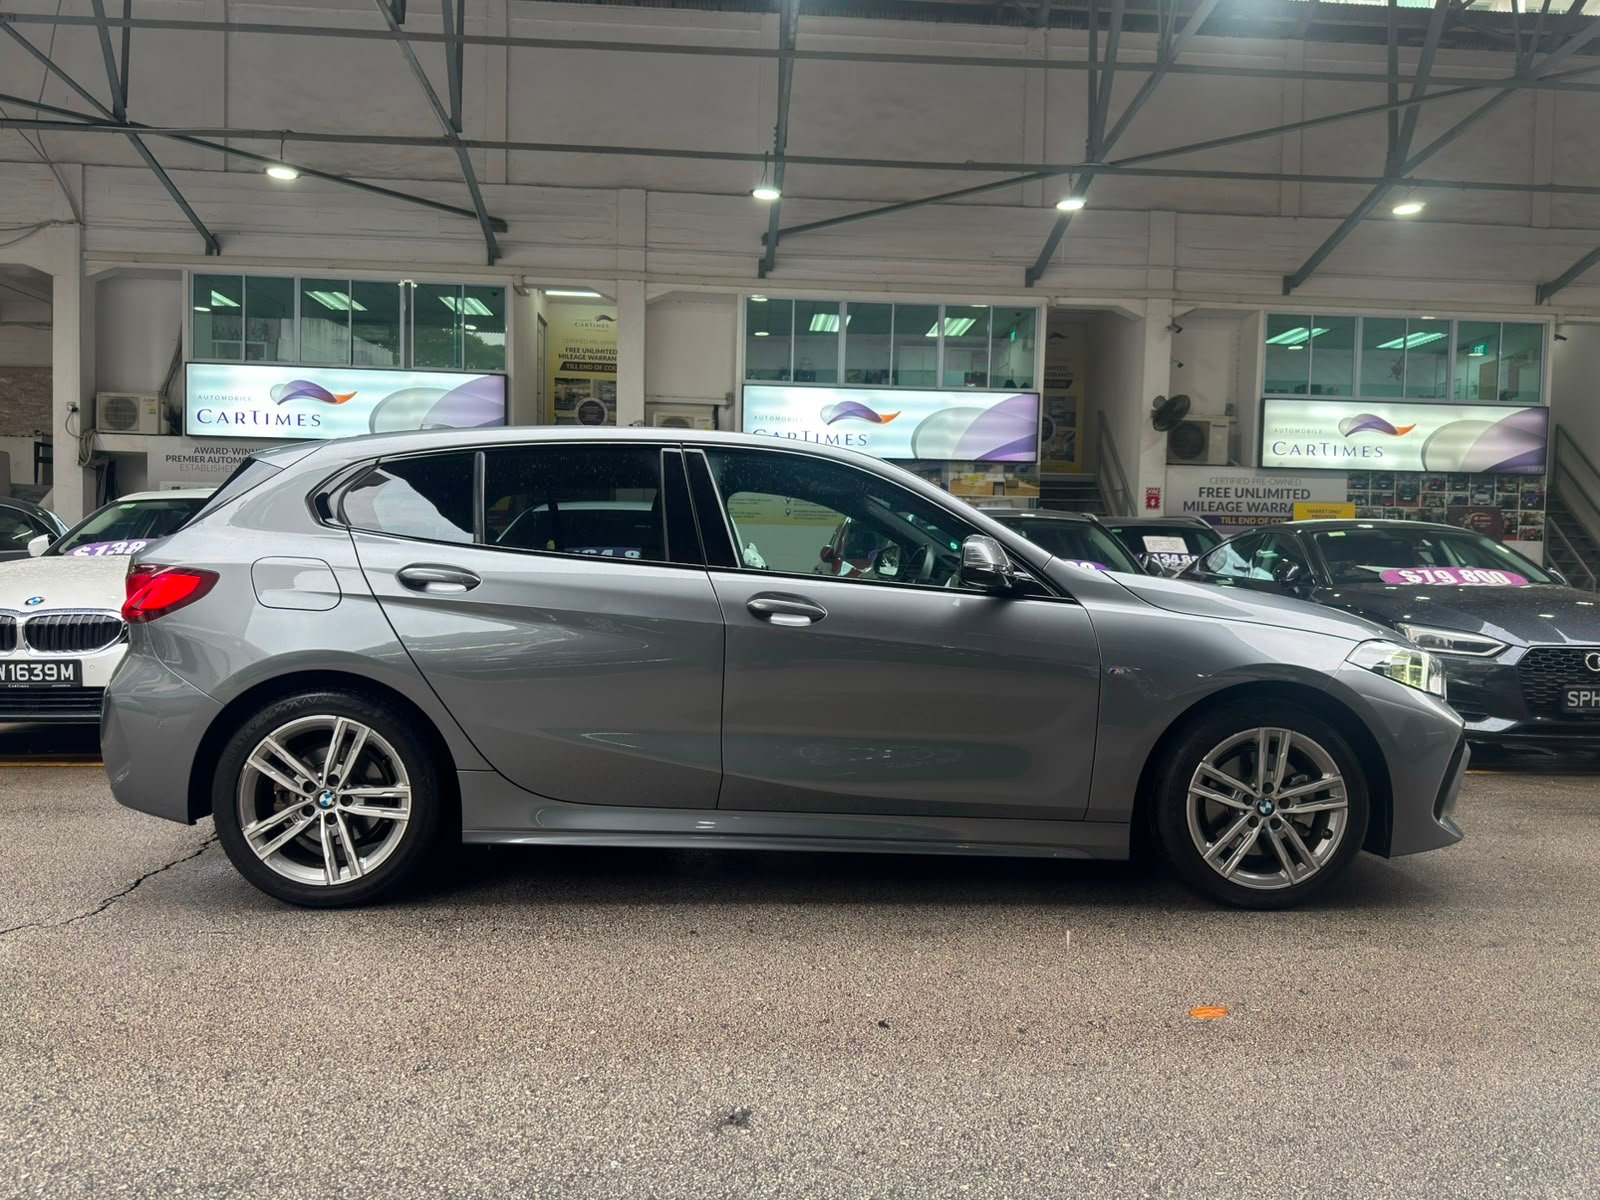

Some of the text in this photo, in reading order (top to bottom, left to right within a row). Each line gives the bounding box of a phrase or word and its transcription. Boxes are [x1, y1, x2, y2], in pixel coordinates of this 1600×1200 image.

[166, 455, 205, 463] PREMIER
[180, 463, 236, 473] ESTABLISHED
[1209, 477, 1302, 486] CERTIFIED PRE-OWNED
[1199, 487, 1311, 500] FREE UNLIMITED
[1183, 501, 1242, 513] MILEAGE
[1221, 516, 1238, 524] TILL
[1239, 517, 1254, 525] END
[1256, 517, 1268, 525] OF
